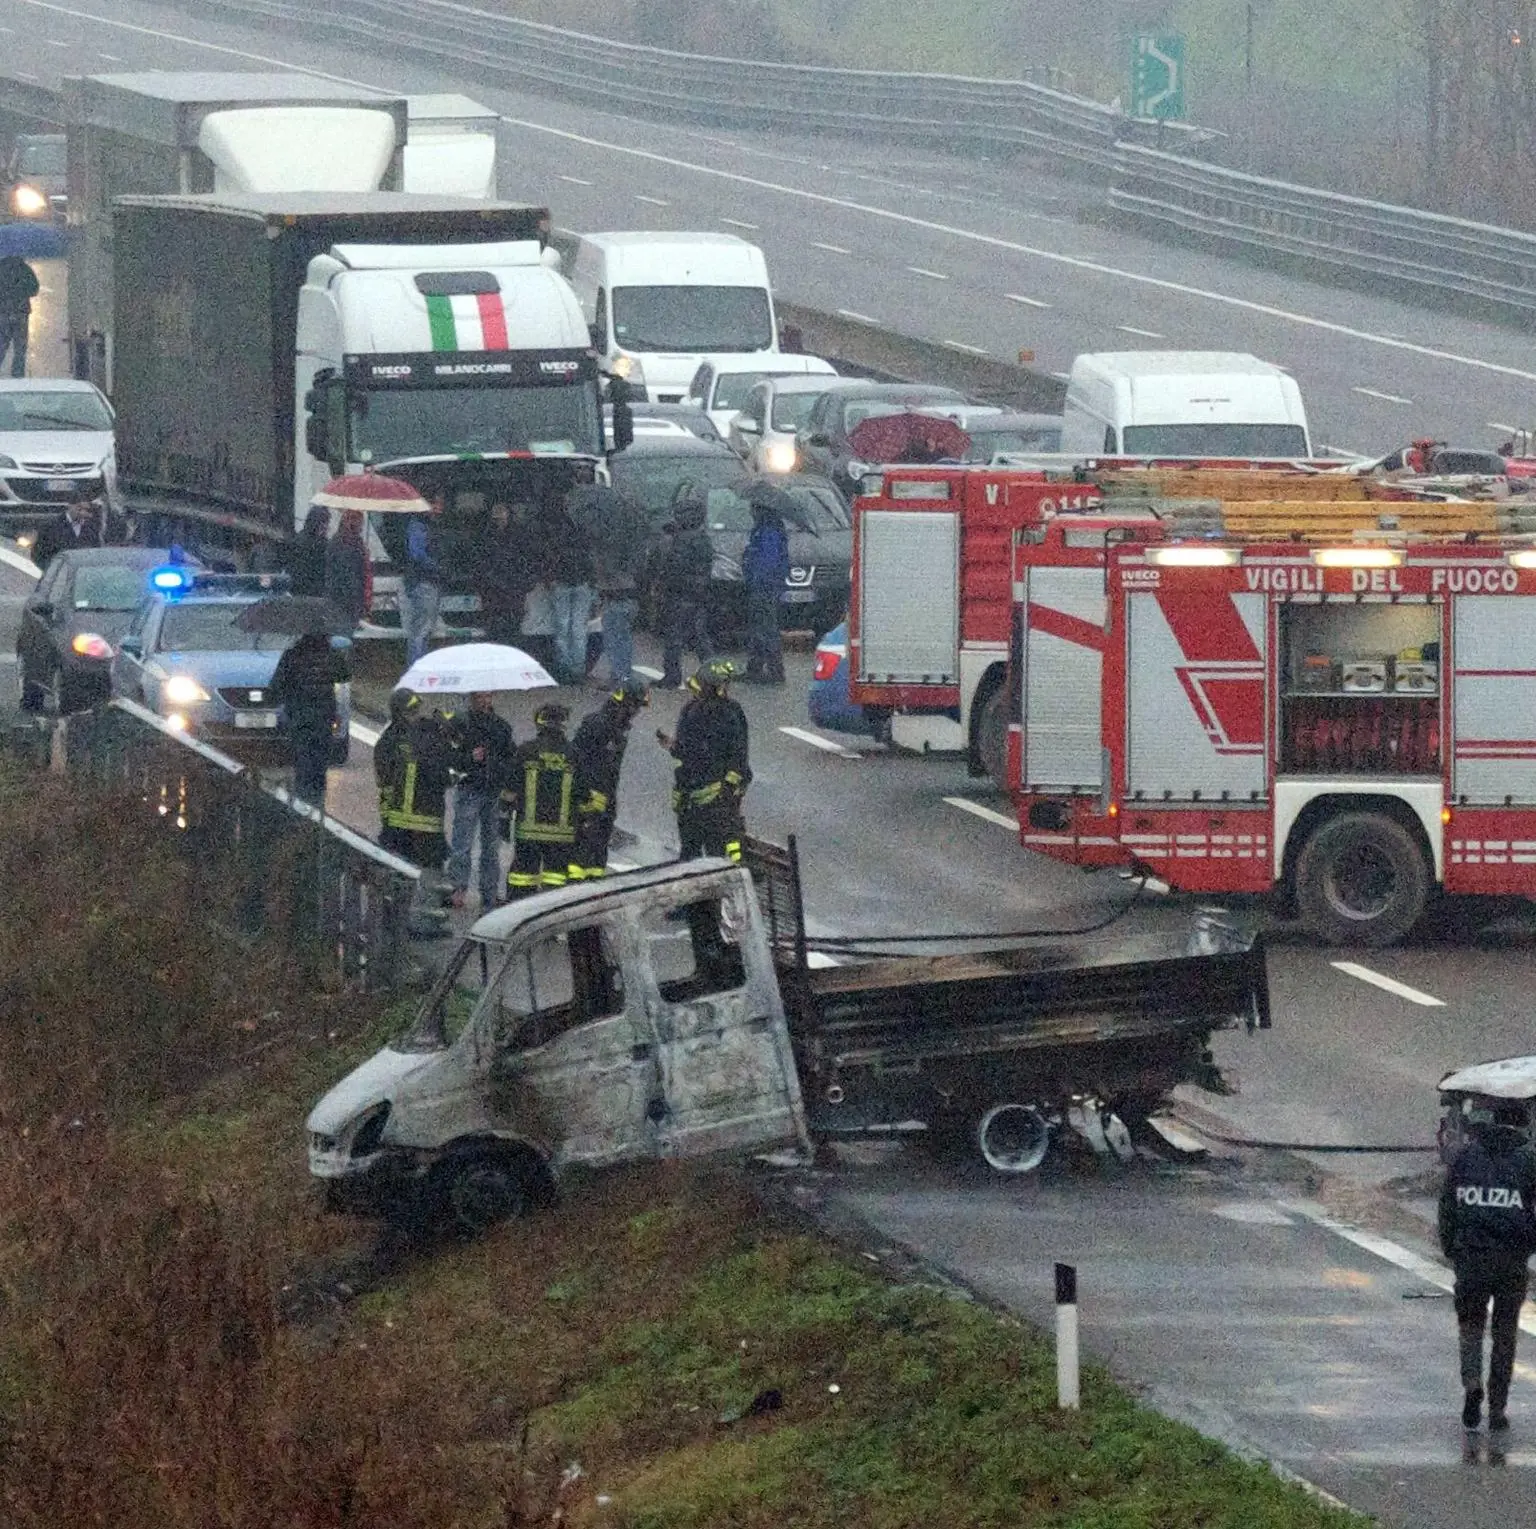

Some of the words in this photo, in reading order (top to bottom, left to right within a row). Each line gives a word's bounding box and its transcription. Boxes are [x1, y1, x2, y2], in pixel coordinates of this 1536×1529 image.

[372, 366, 411, 375] IVECO
[540, 361, 578, 371] IVECO
[1121, 571, 1160, 580] IVECO
[1246, 568, 1324, 591] VIGILI
[1352, 568, 1404, 592] DEL
[1432, 568, 1518, 592] FUOCO
[1456, 1186, 1524, 1209] POLIZIA
